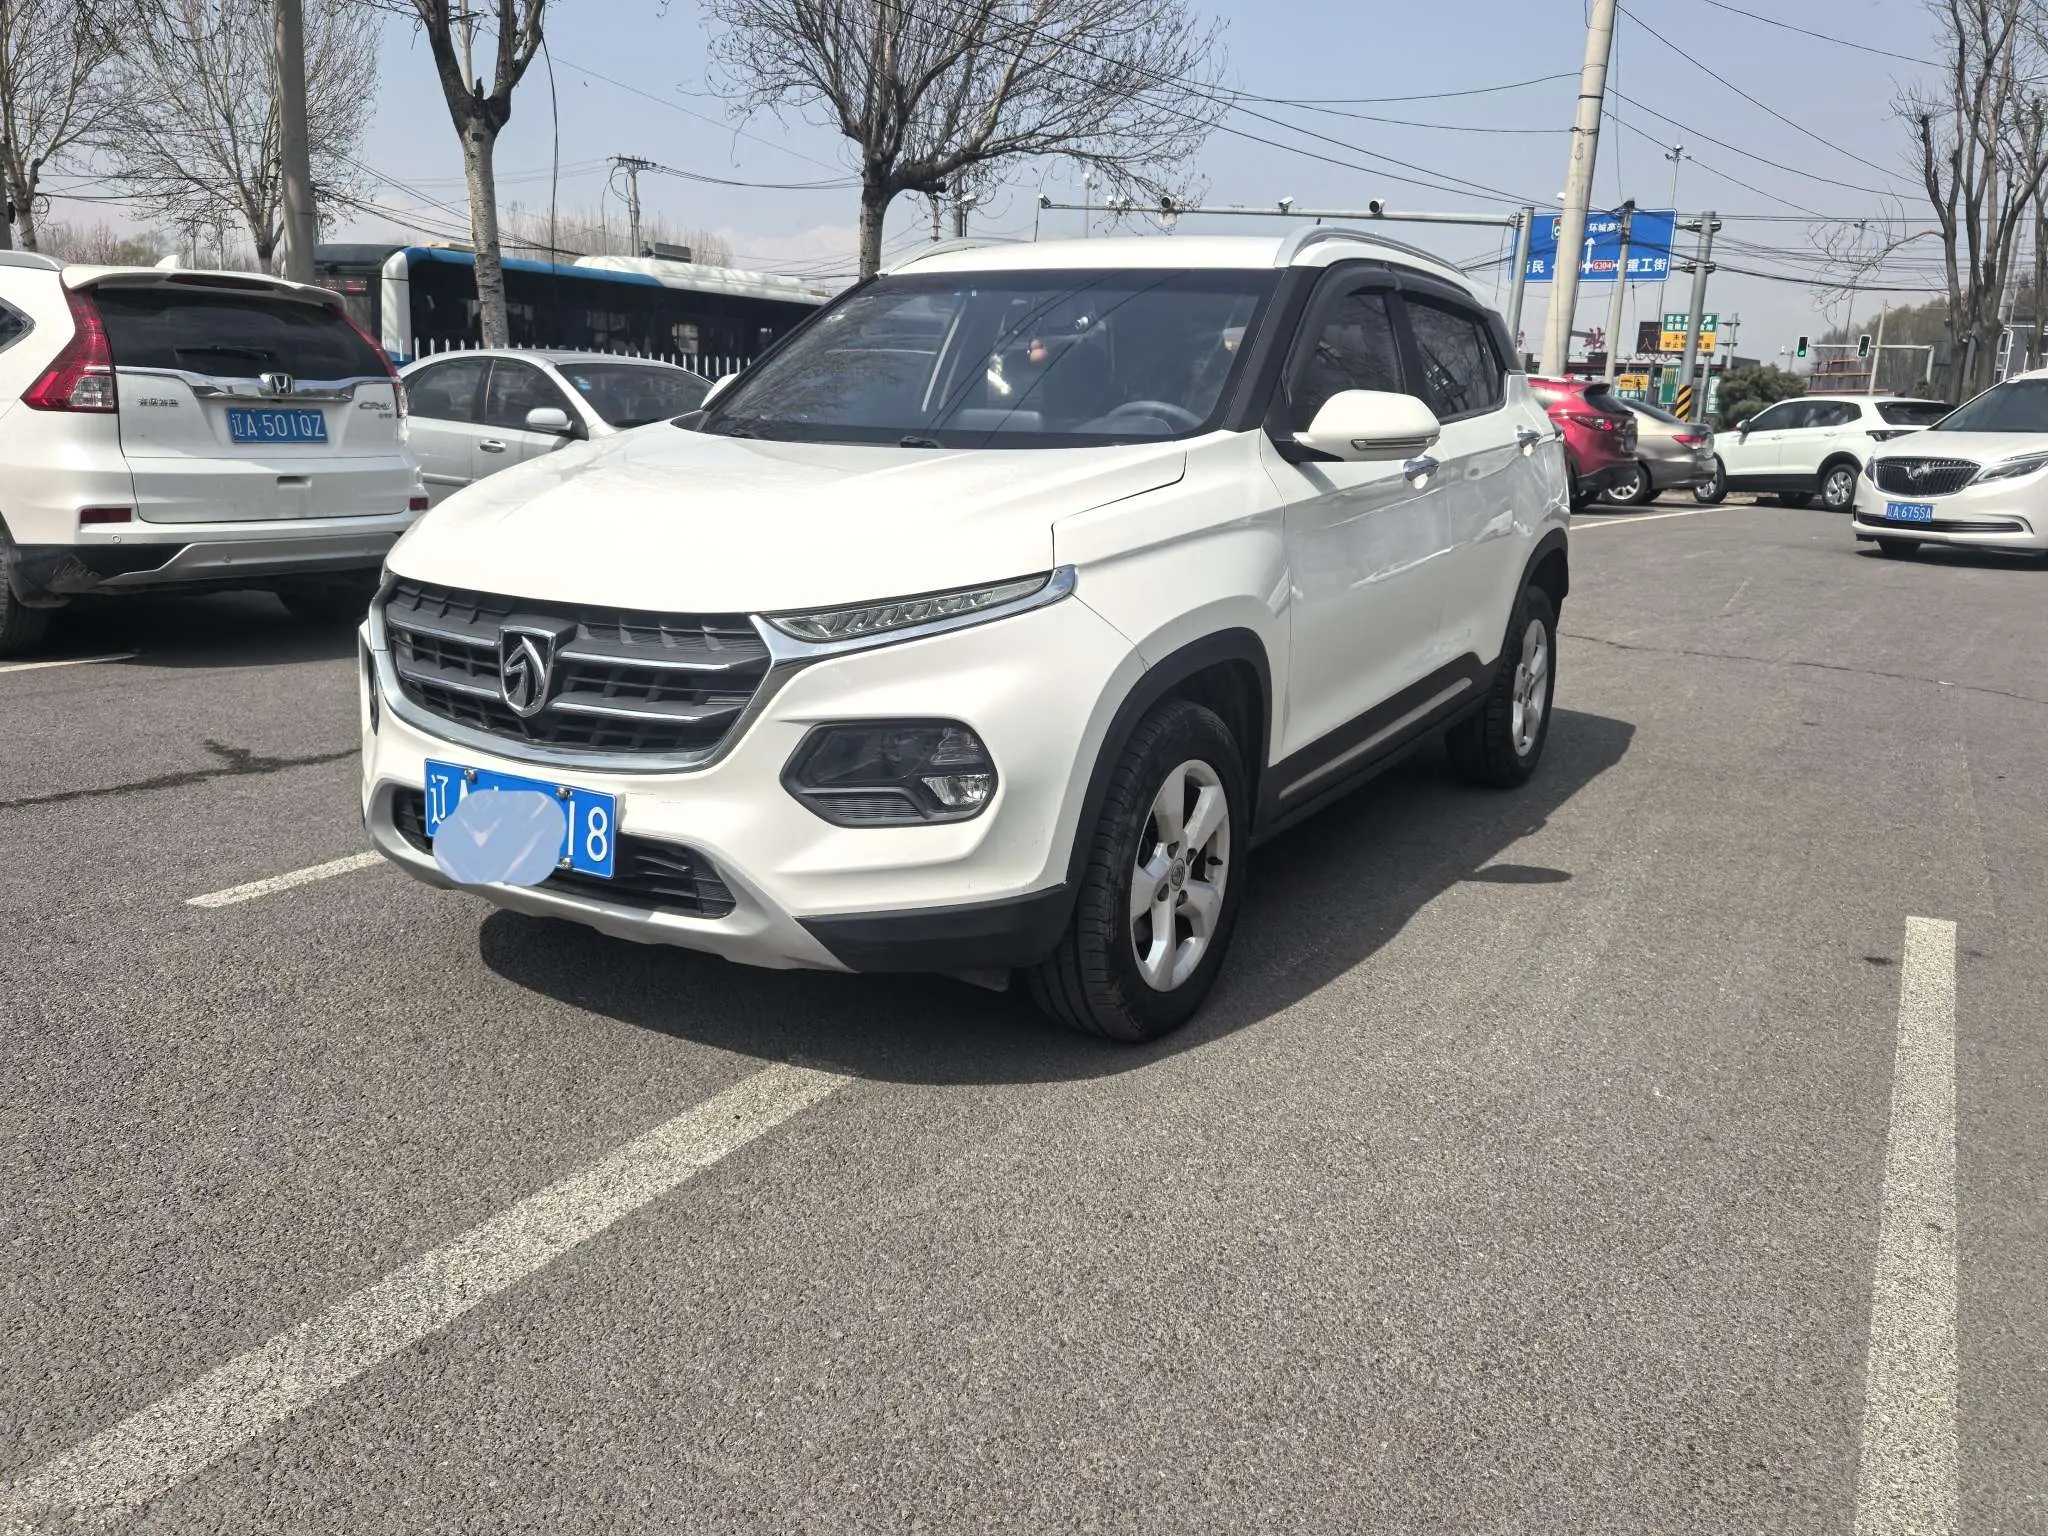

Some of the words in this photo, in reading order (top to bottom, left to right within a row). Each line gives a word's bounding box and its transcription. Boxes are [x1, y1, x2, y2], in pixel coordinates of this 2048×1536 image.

[1593, 261, 1613, 271] G304
[1627, 258, 1667, 272] 重工街
[1583, 327, 1606, 349] 站
